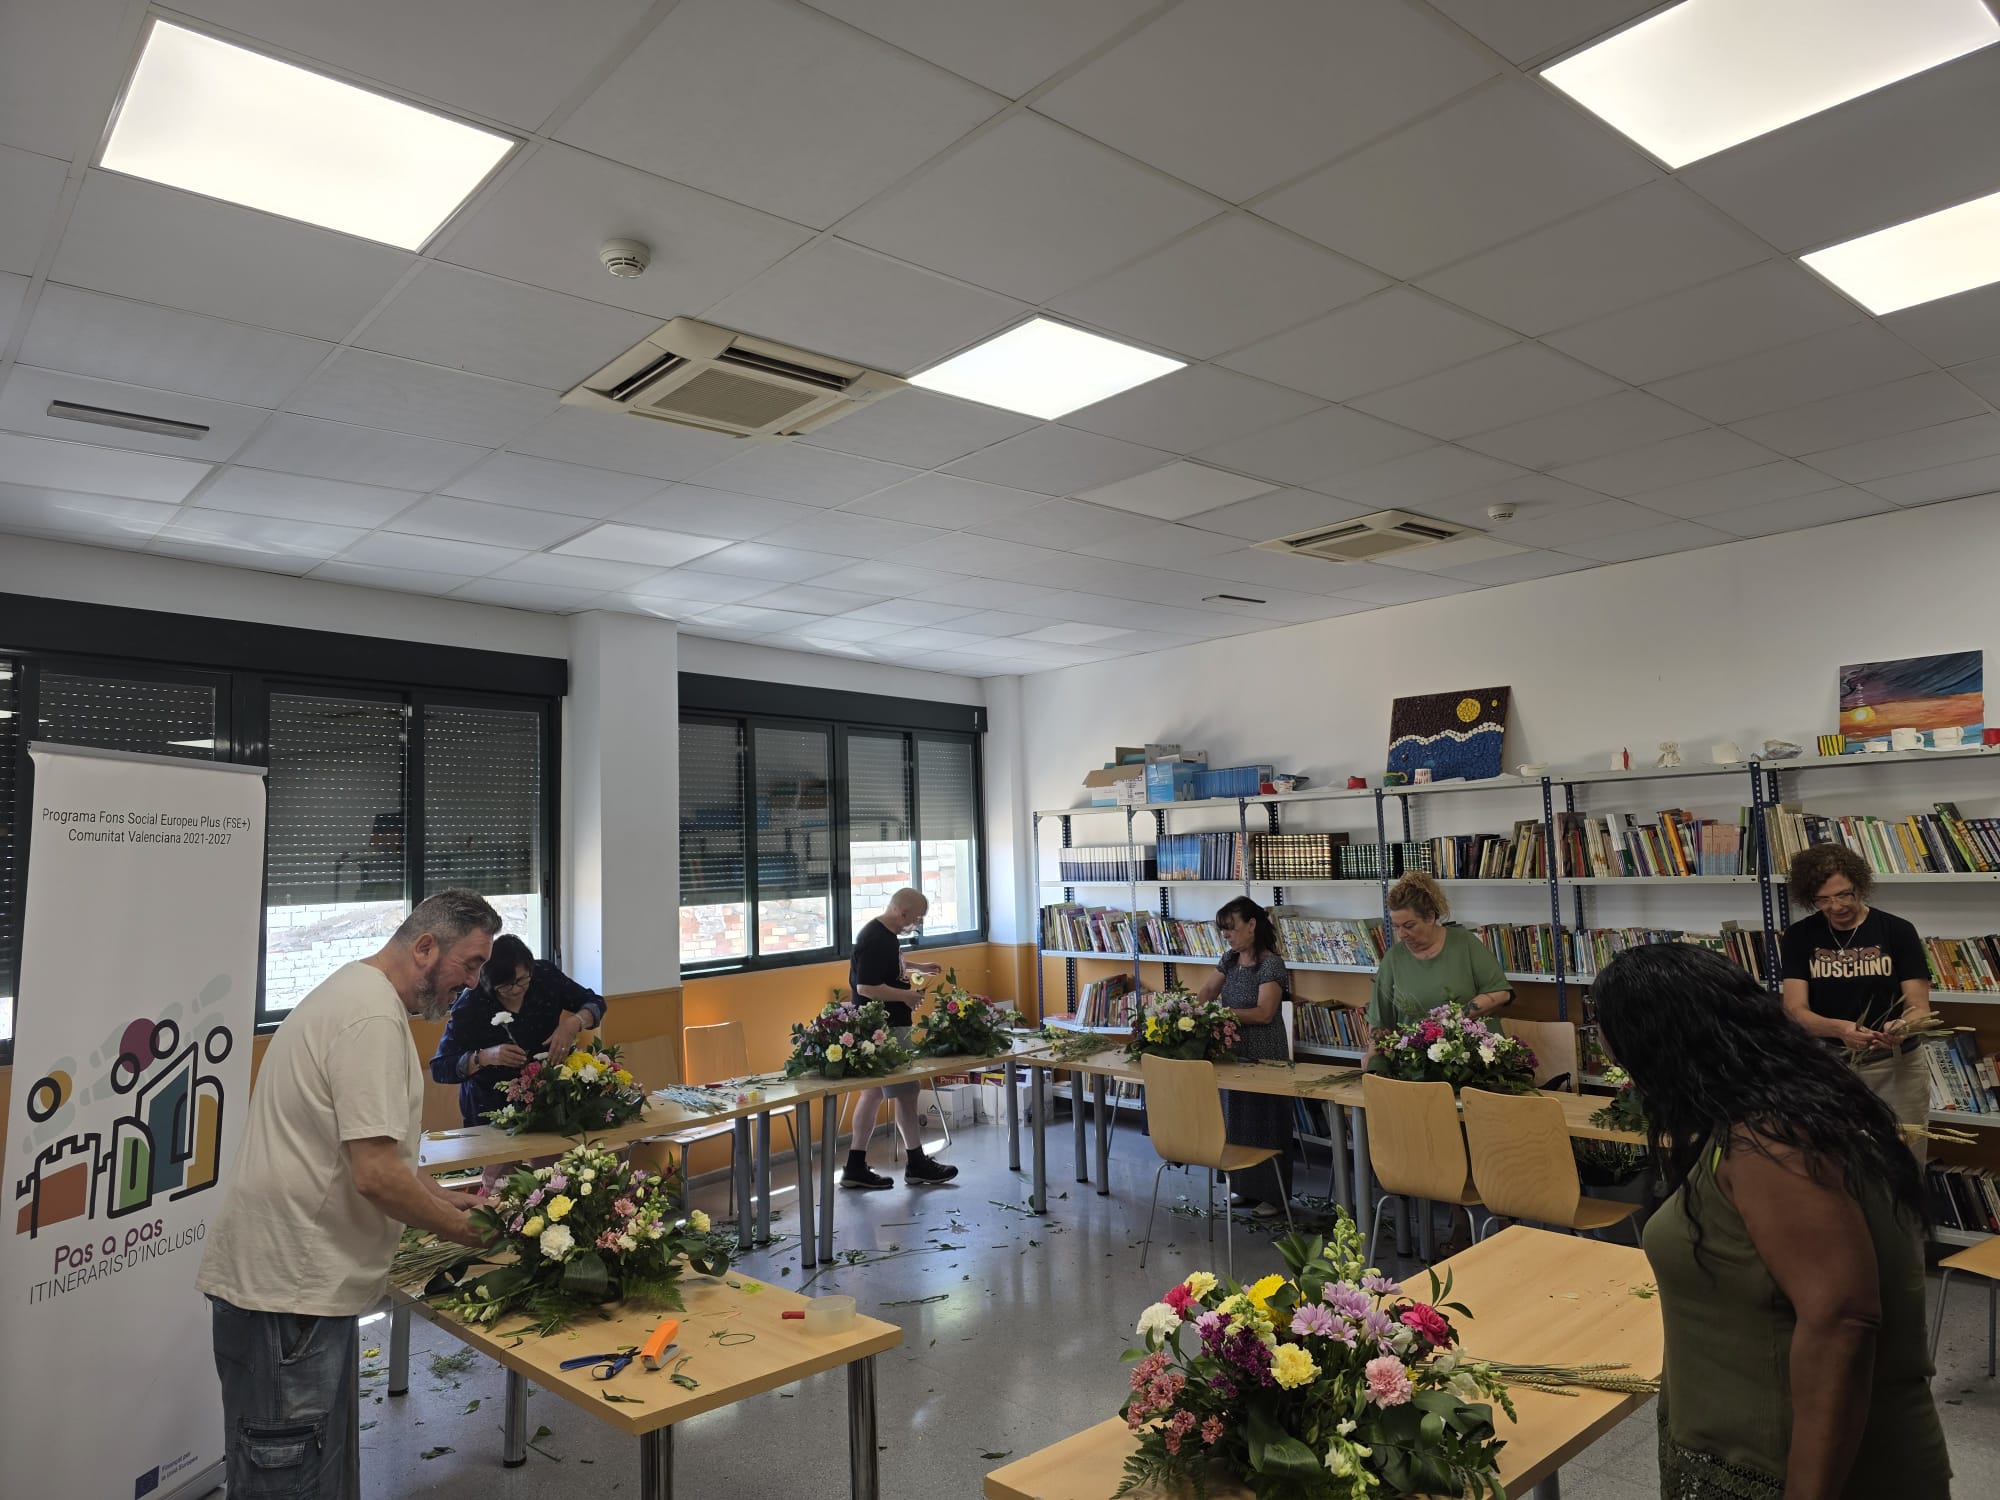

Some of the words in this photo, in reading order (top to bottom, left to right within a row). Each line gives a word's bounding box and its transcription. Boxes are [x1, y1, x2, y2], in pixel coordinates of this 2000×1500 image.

[42, 808, 96, 825] Programa
[99, 810, 125, 824] Fons
[127, 812, 158, 825] Social
[160, 814, 198, 829] Europeu
[200, 815, 221, 828] Plus
[222, 816, 251, 831] (FSE+)
[68, 828, 125, 843] Comunitat
[128, 830, 181, 844] Valenciana
[183, 833, 232, 845] 2021-2027
[30, 1255, 124, 1305] ITINERARIS
[128, 1218, 206, 1268] D'INCLUSIÓ
[54, 1243, 94, 1275] Pas
[101, 1235, 117, 1256] a
[124, 1218, 164, 1258] pas
